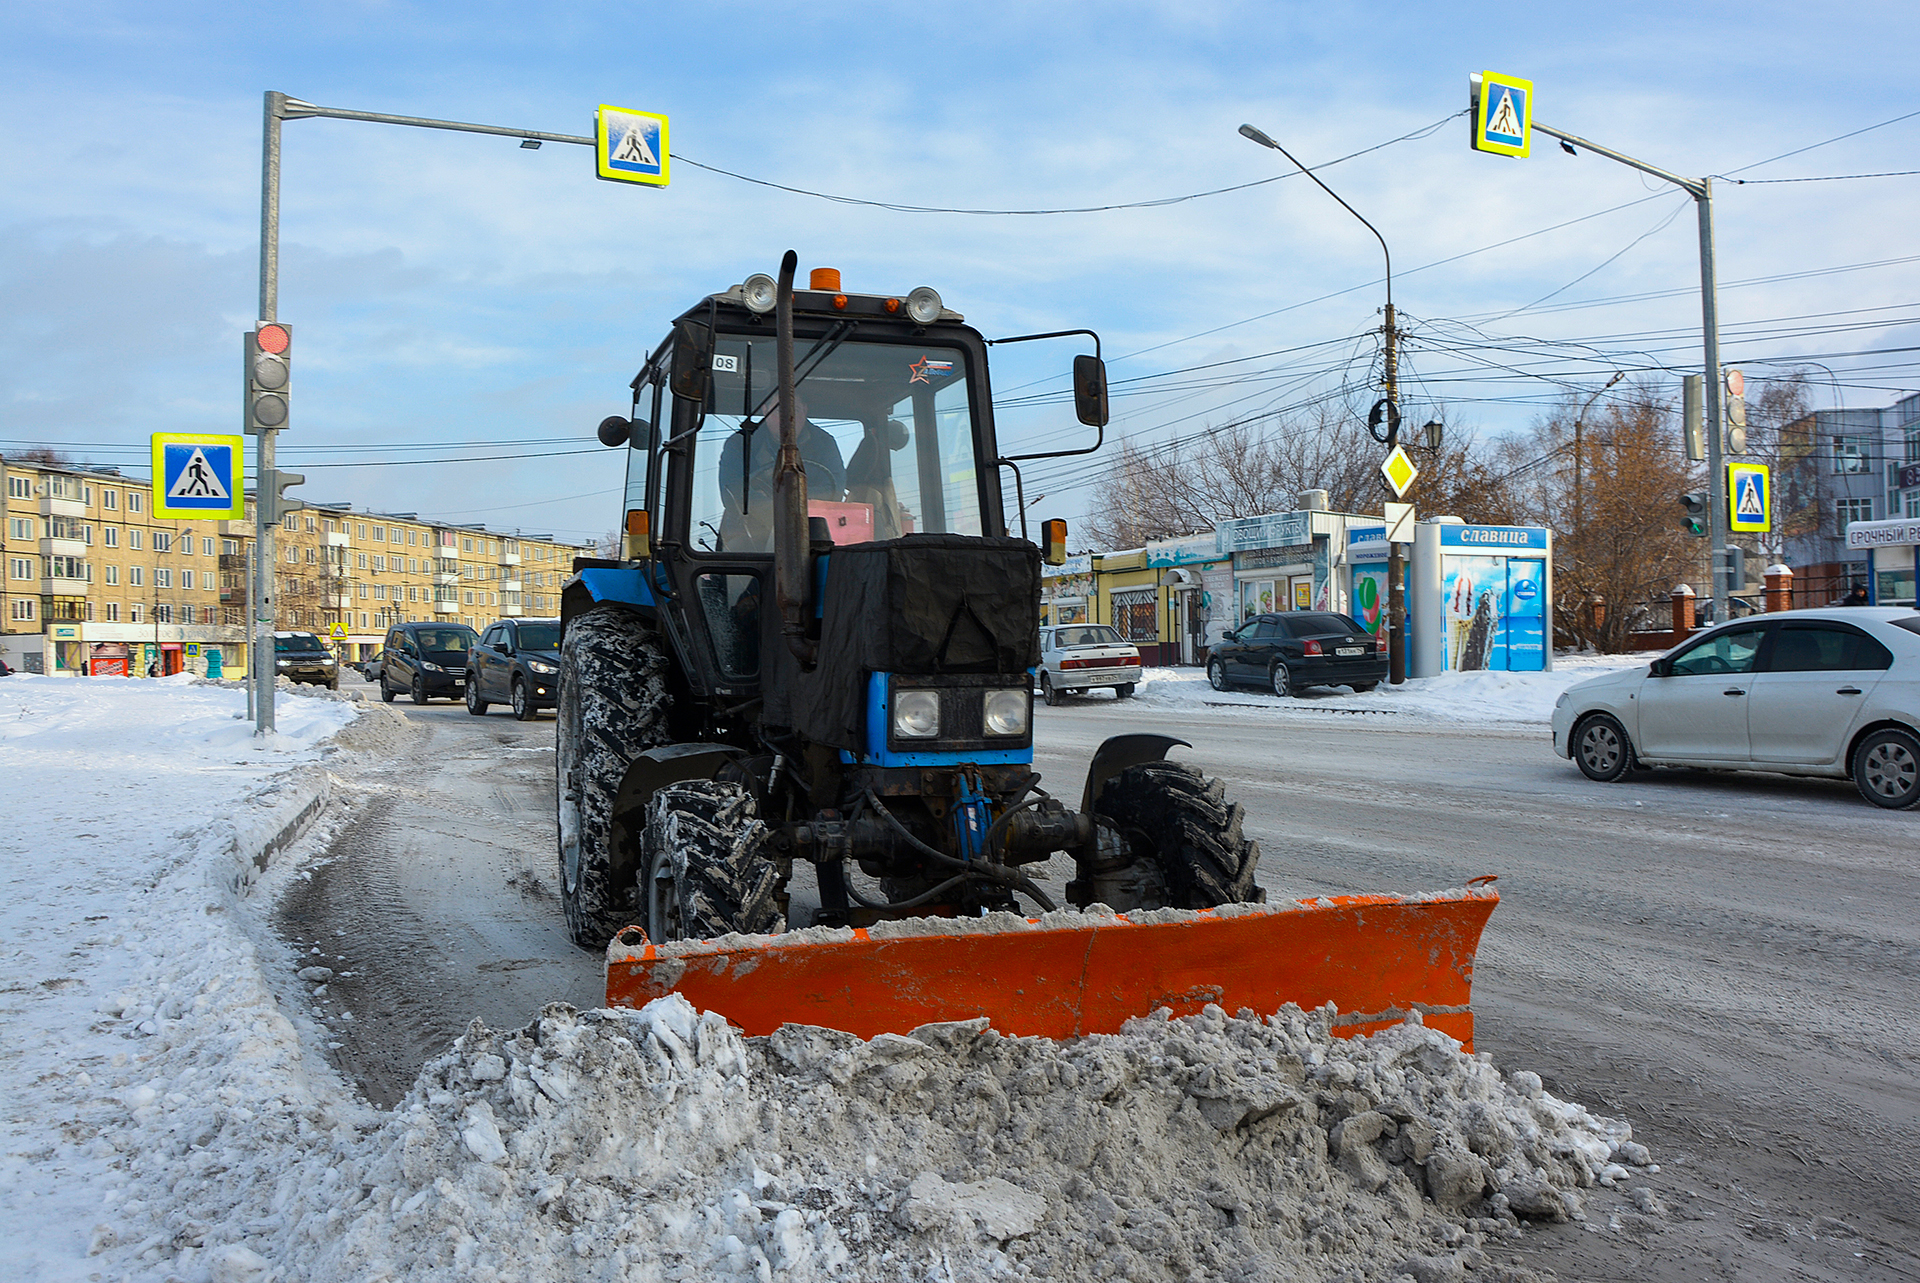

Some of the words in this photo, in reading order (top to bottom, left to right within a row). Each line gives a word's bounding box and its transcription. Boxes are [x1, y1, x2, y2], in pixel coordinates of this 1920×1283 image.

[716, 357, 734, 369] 08
[1270, 522, 1301, 536] ФРУКТЫ
[1850, 525, 1904, 544] СРОЧНЫЙ
